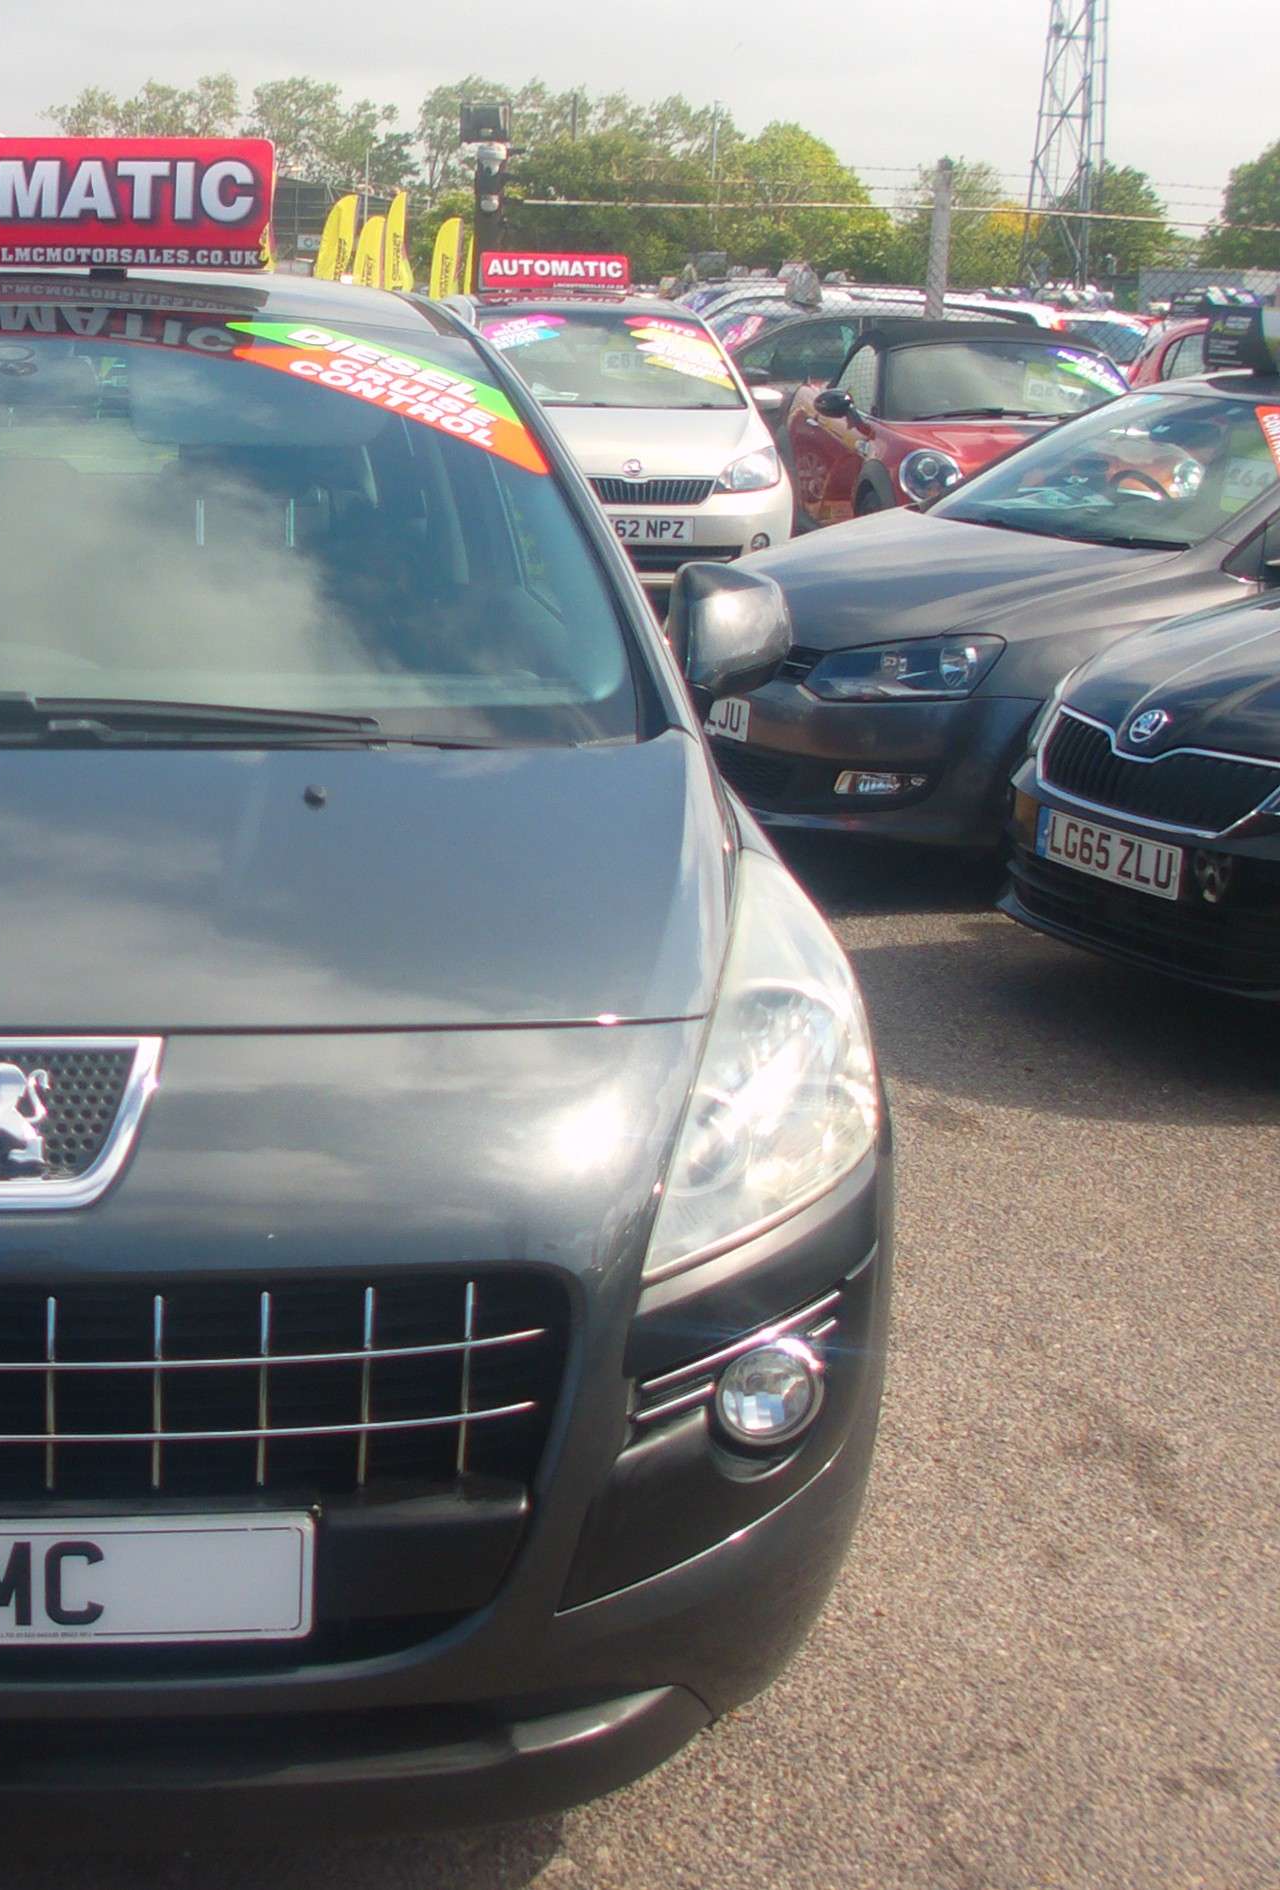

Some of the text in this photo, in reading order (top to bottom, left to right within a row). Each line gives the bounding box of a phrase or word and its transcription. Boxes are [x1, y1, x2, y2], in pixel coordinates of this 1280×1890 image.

[0, 248, 259, 266] LMCMOTORSALES.CO.UK
[488, 259, 623, 278] AUTOMATIC
[647, 320, 697, 338] AUTO
[286, 328, 480, 405] DIESEL
[289, 360, 494, 448] CONTROL
[329, 359, 498, 428] CRUISE
[646, 520, 684, 539] NPZ
[1049, 815, 1174, 890] LG65 ZLU
